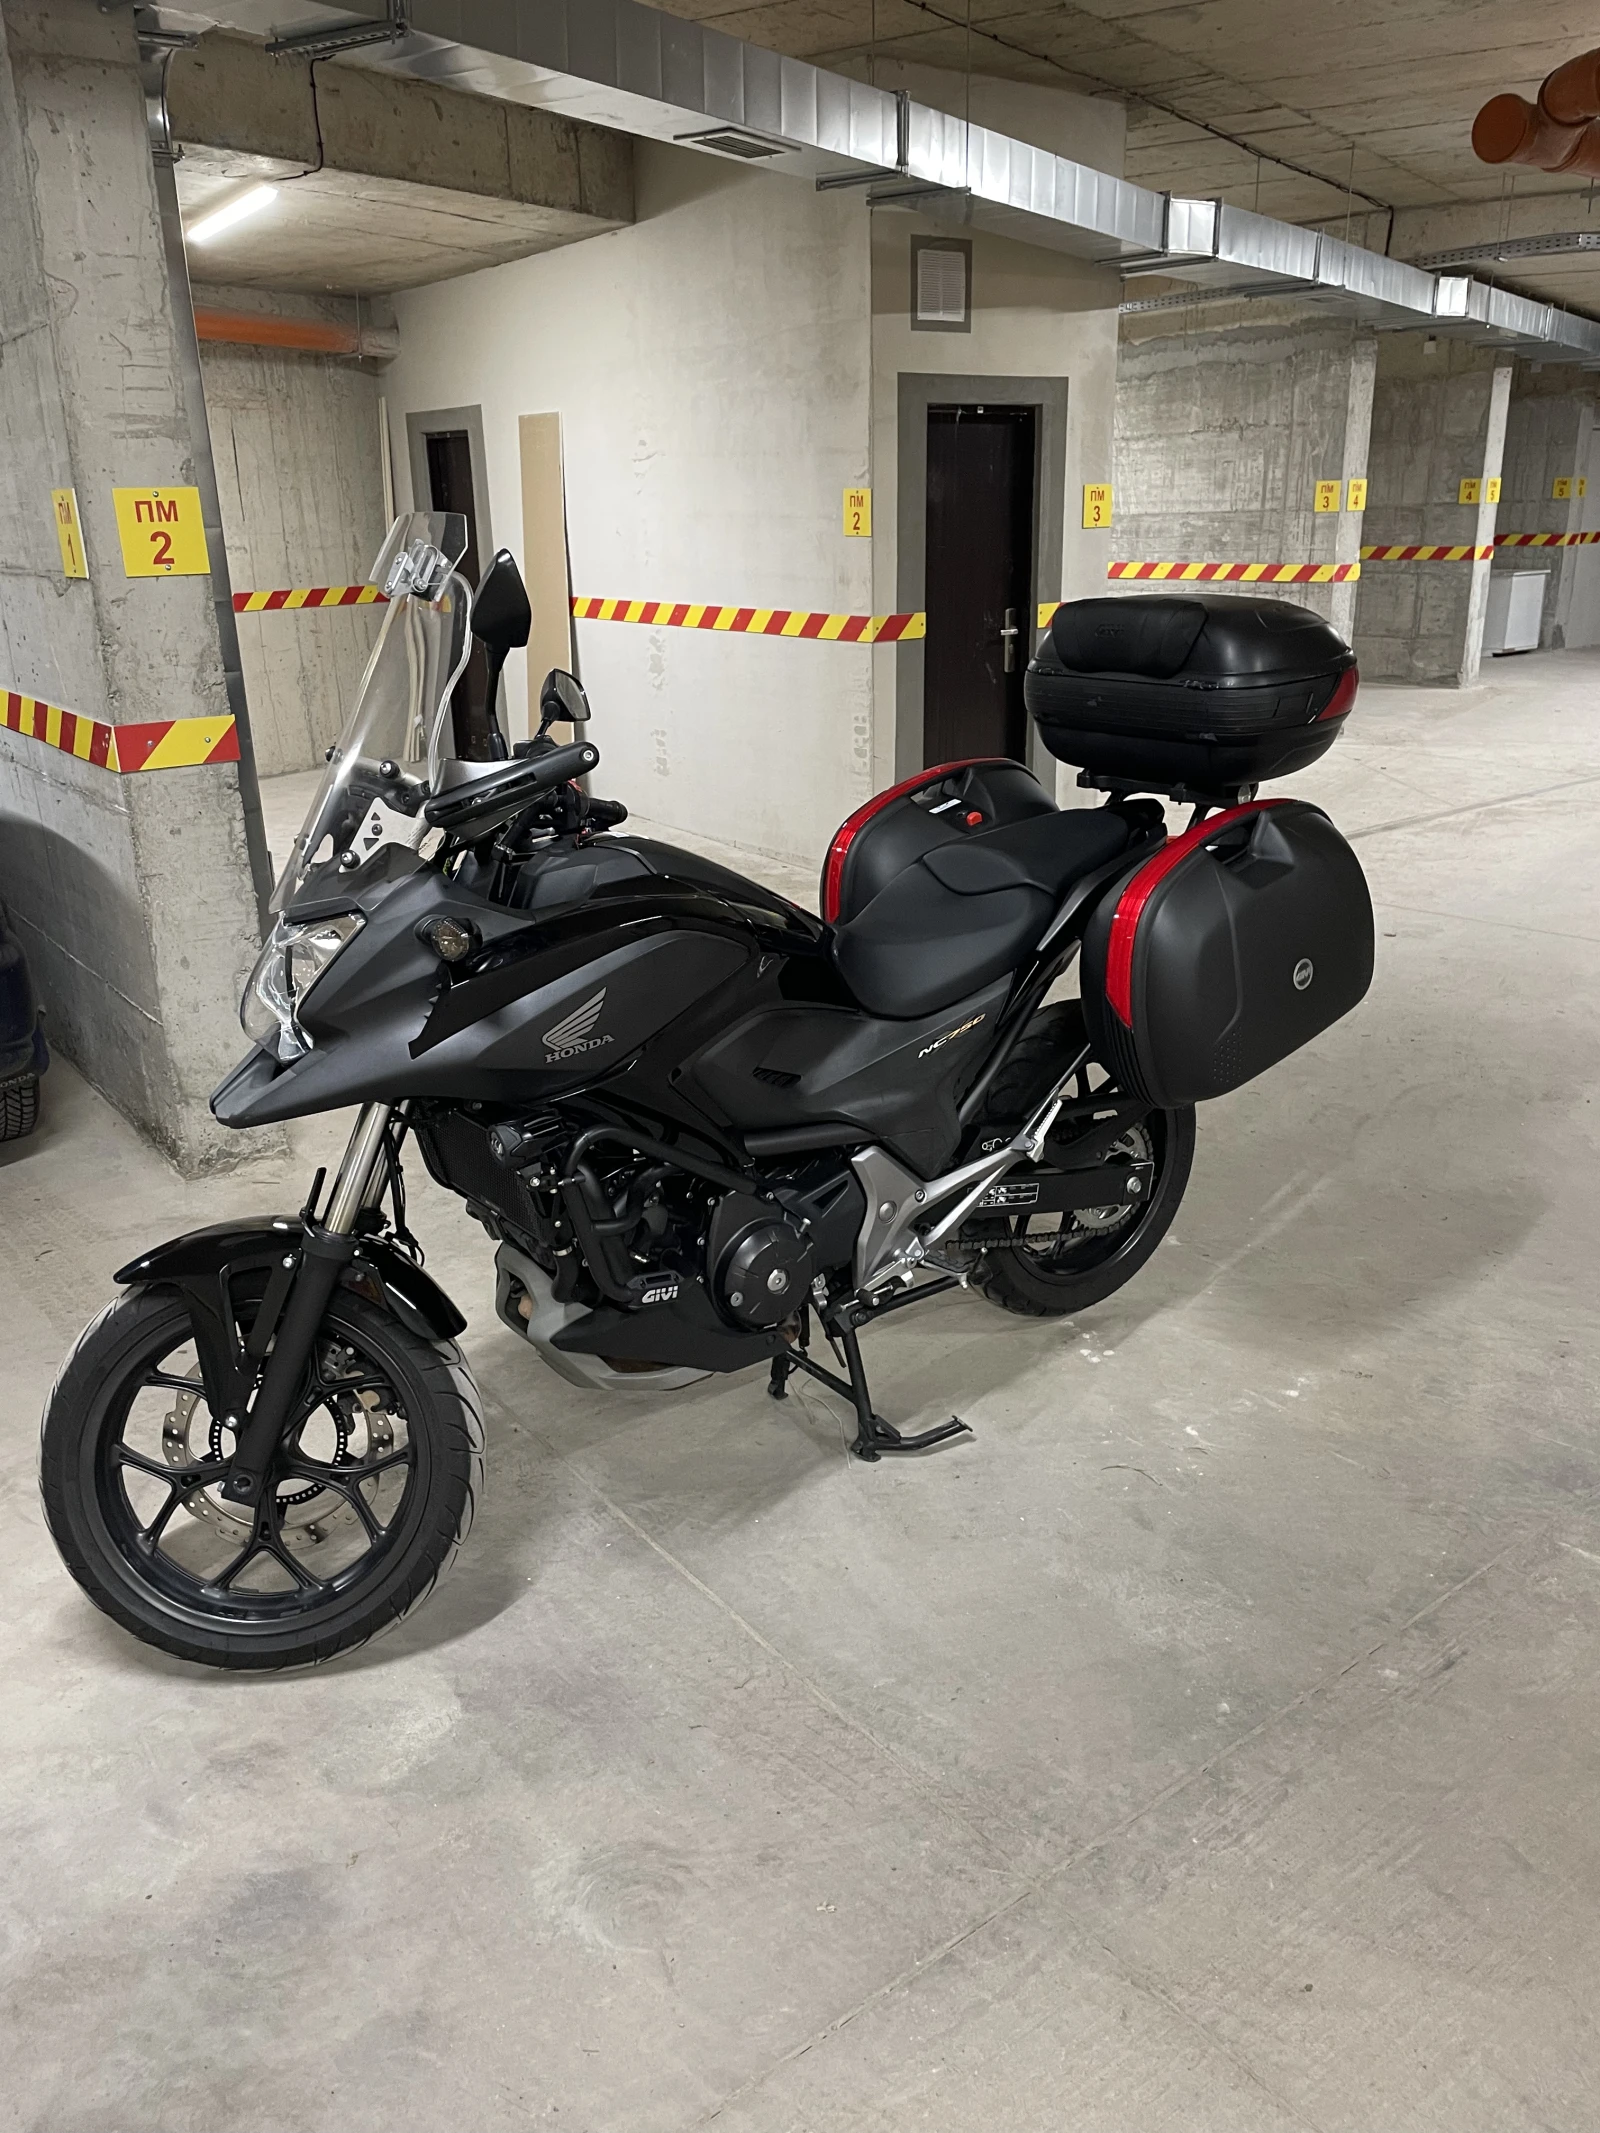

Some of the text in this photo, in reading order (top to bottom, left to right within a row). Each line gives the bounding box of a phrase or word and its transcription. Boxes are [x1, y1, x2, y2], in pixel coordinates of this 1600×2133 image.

[1091, 490, 1105, 501] ПМ
[1320, 484, 1334, 493] ПМ
[1465, 491, 1473, 501] 4
[1490, 490, 1495, 501] 5
[1558, 487, 1564, 497] 5
[850, 495, 864, 508] ПМ
[1322, 495, 1330, 509] 3
[1353, 494, 1359, 508] 4
[58, 502, 72, 525] ПМ
[134, 500, 179, 523] ПМ
[1093, 505, 1101, 522] 3
[853, 511, 861, 531] 2
[67, 533, 76, 566] 1
[150, 531, 175, 565] 2
[545, 1034, 615, 1064] HONDA
[642, 1285, 679, 1304] GIVI
